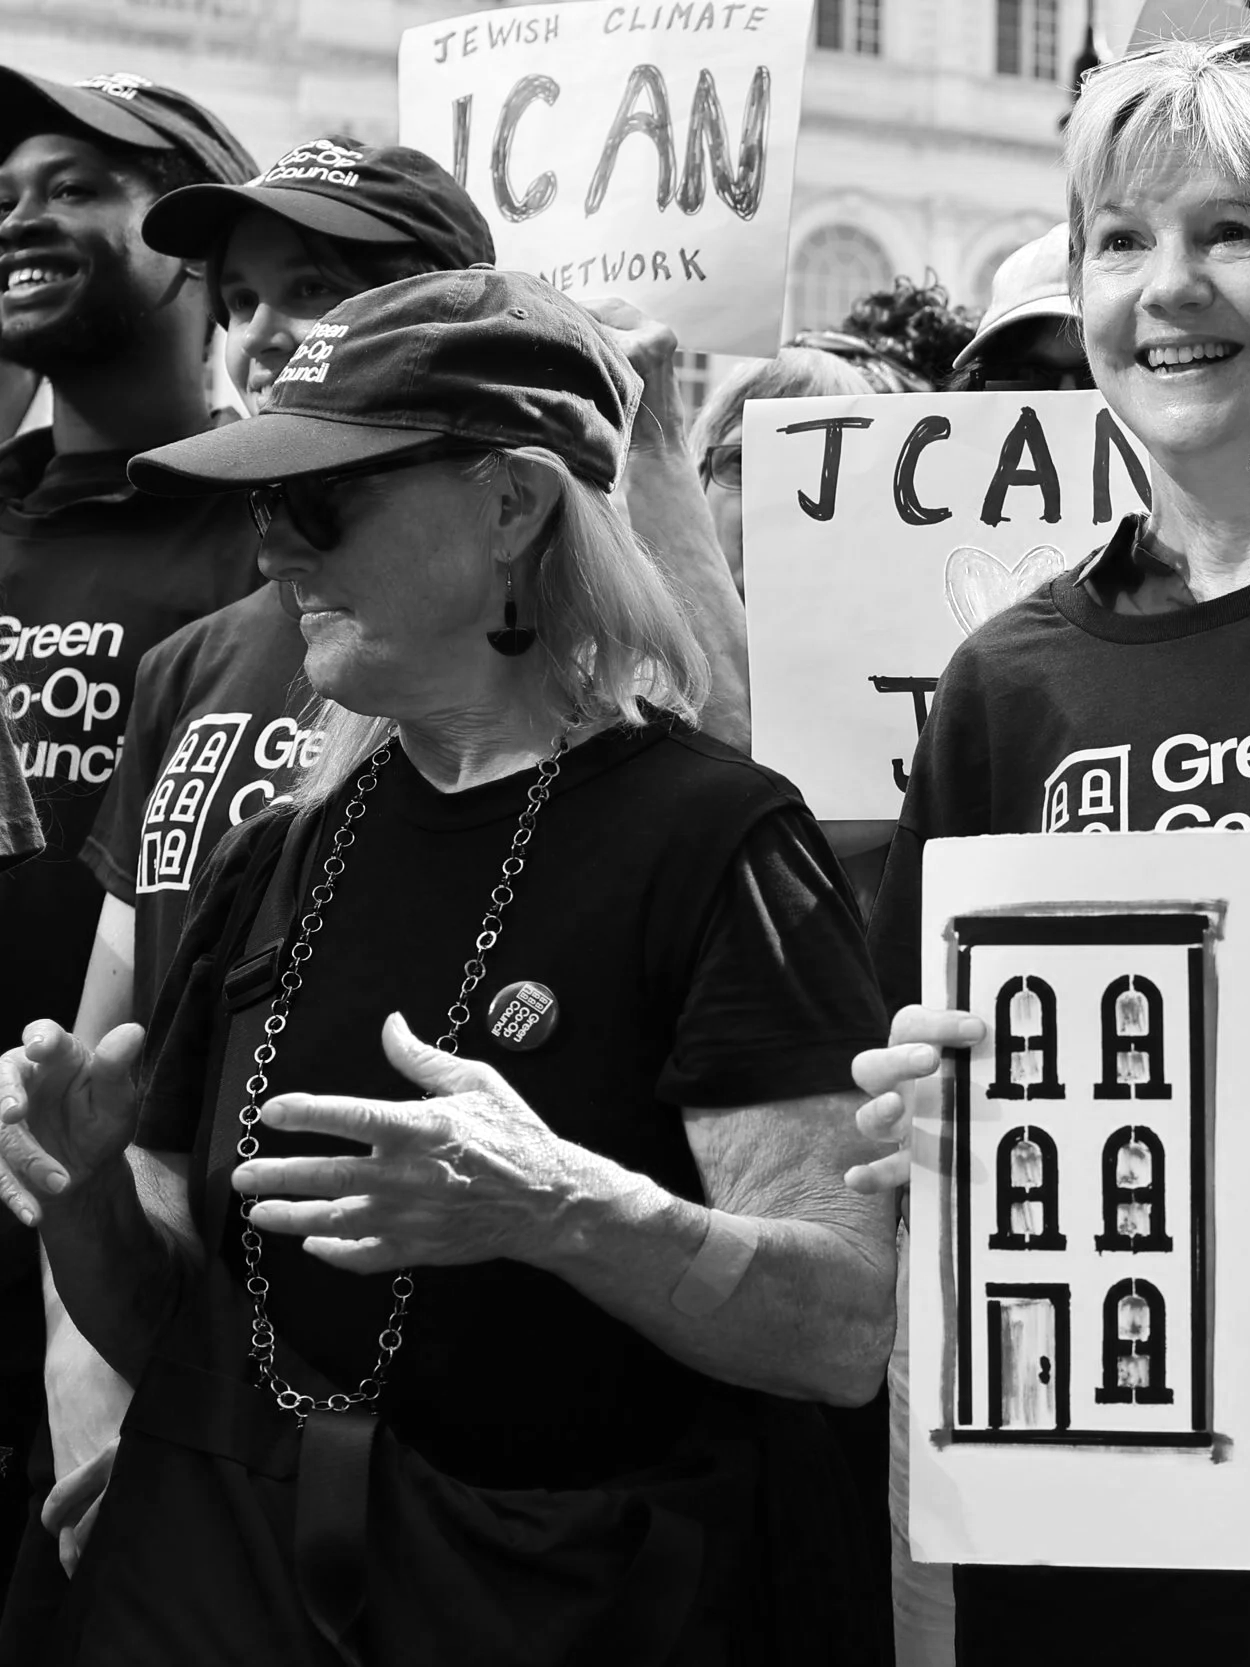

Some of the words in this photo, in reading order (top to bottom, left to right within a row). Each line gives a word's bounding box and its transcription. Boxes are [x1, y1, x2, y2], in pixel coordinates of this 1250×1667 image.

[434, 15, 559, 64] JEWISH
[603, 1, 769, 35] CLIMATE
[278, 150, 357, 168] Co-Op
[265, 166, 360, 187] Council
[539, 247, 707, 292] NETWORK
[304, 322, 350, 339] reen
[290, 340, 334, 363] o-Op
[274, 362, 331, 385] ouncil
[776, 405, 1153, 526] JCAN
[0, 667, 121, 732] o-Op
[254, 717, 328, 769] Gre
[490, 1000, 521, 1037] Council
[503, 1006, 530, 1038] Co-Op
[512, 1013, 540, 1043] Green
